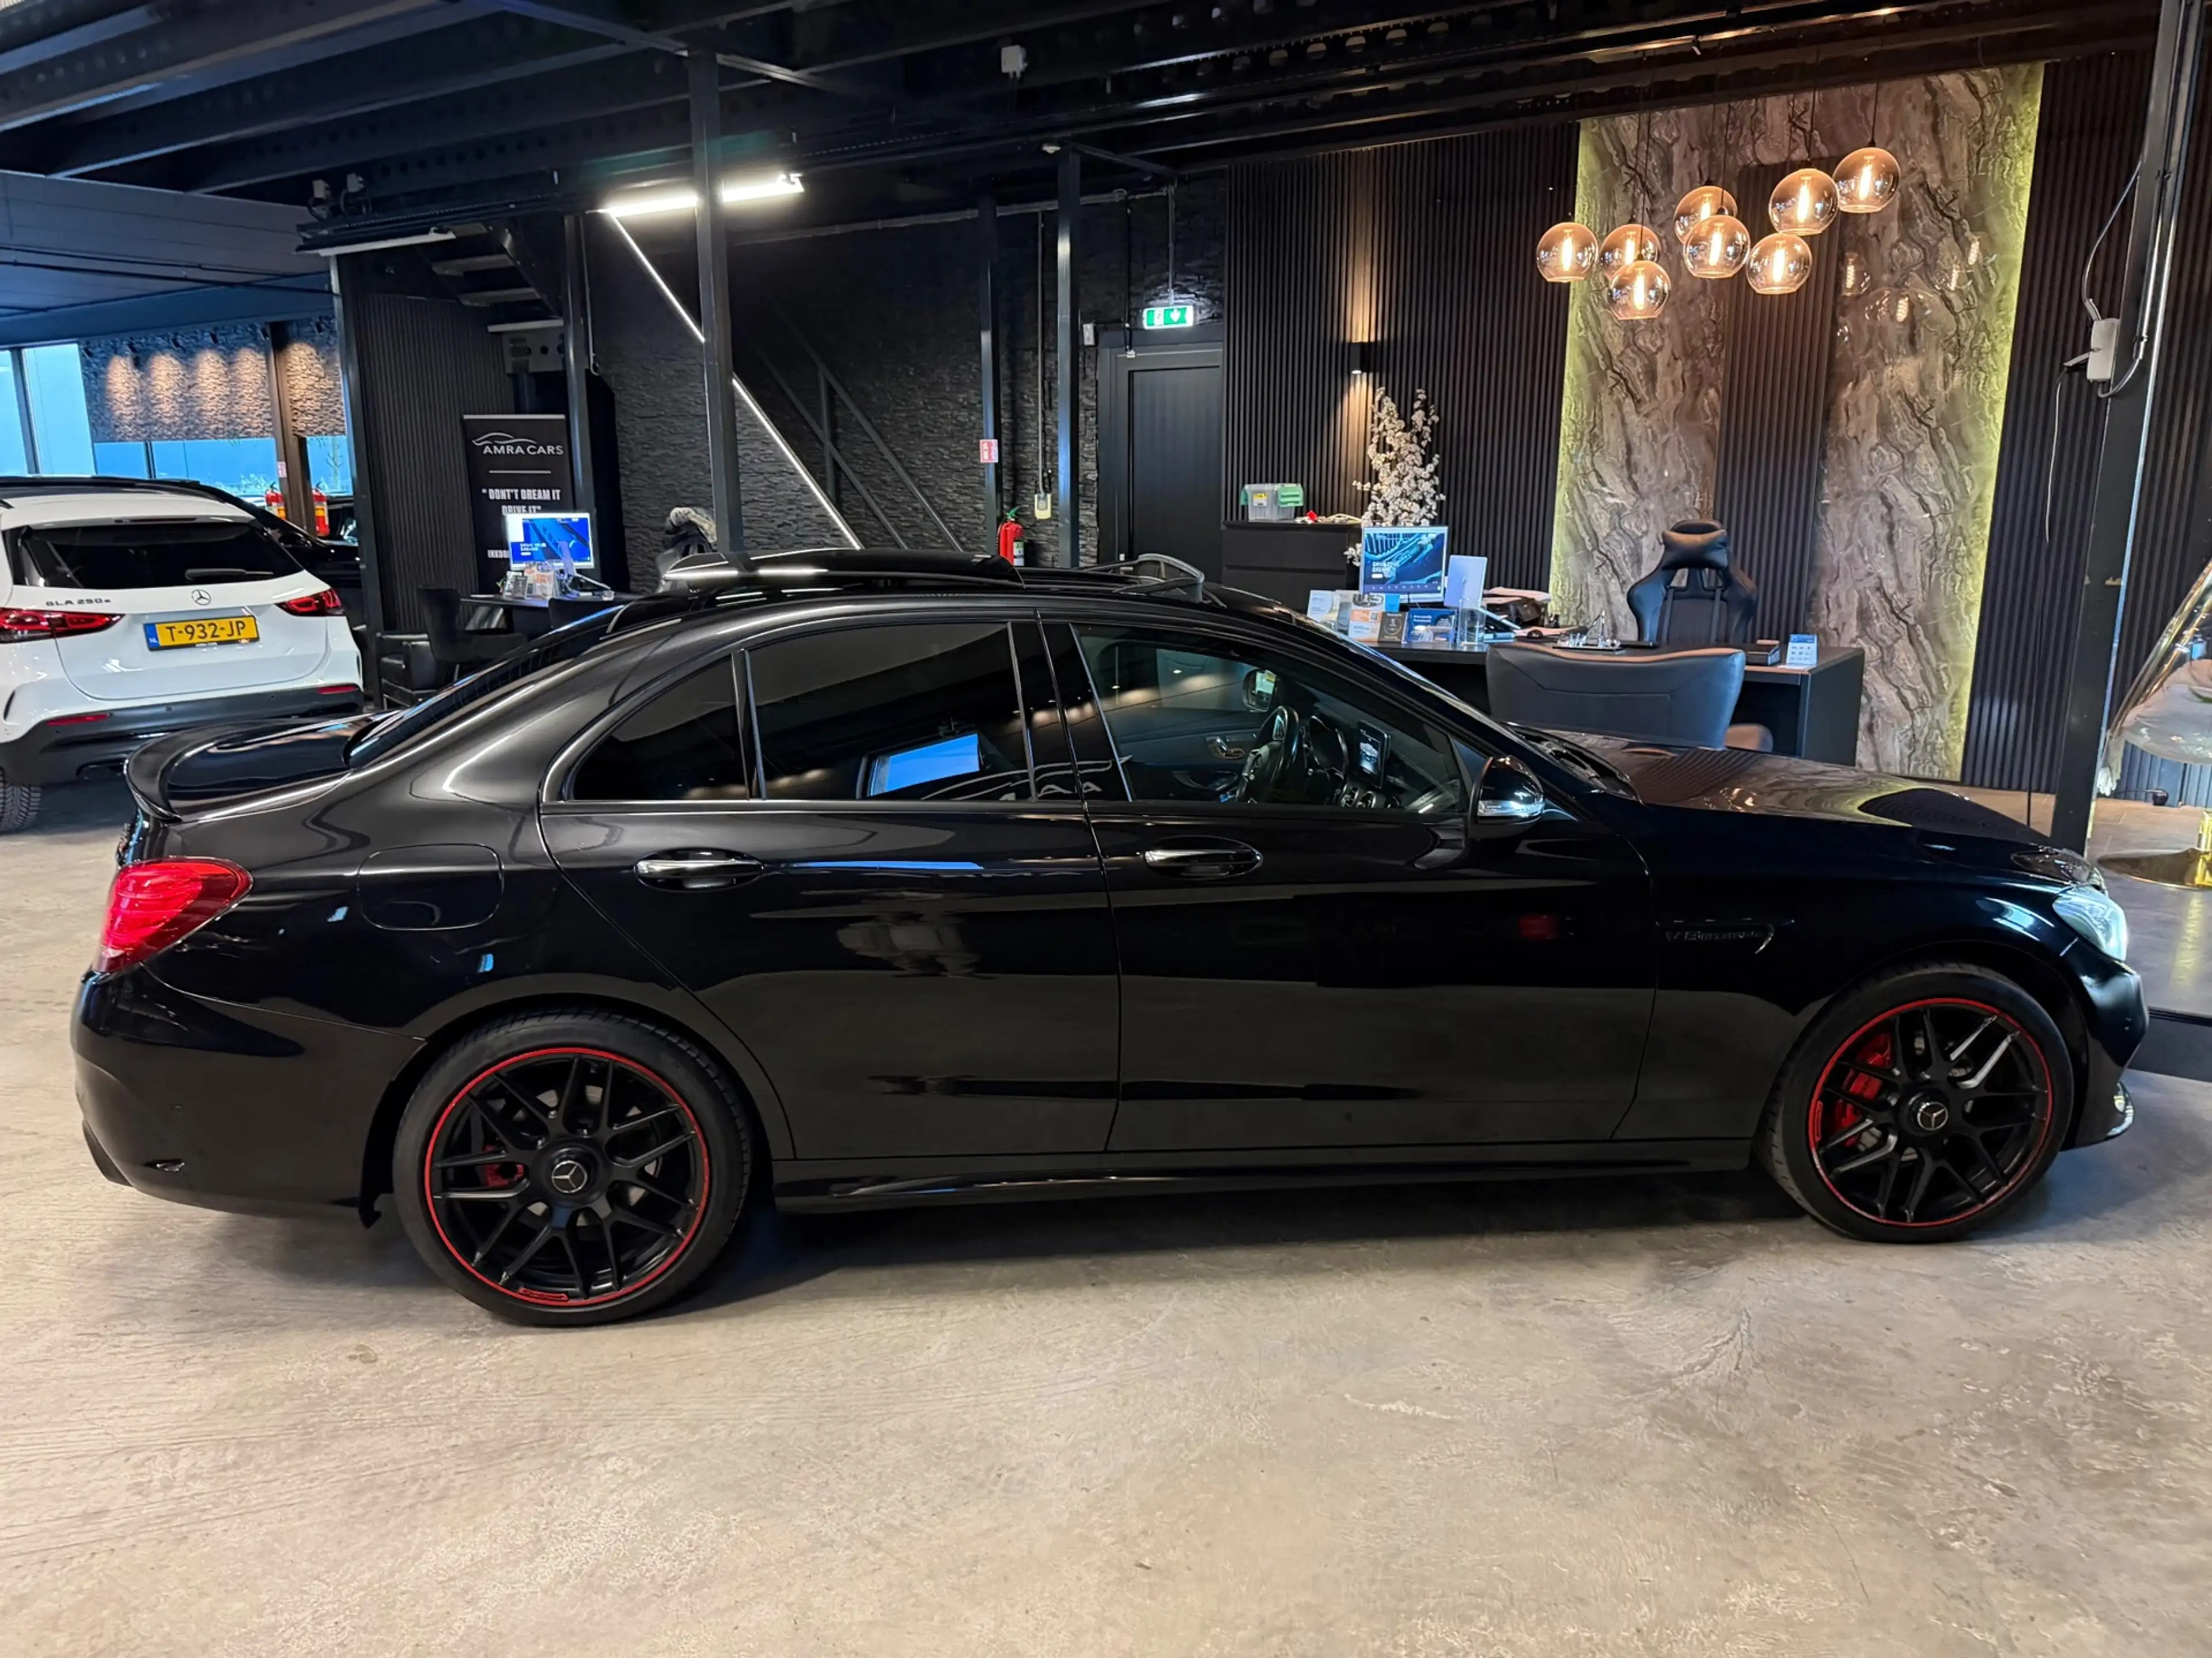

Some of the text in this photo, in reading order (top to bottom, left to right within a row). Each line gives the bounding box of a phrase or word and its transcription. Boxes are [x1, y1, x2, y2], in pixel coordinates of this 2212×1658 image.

[483, 445, 563, 455] AMRA CARS
[520, 489, 551, 500] DREAM
[552, 490, 561, 500] IT
[165, 620, 246, 642] T-932-JP
